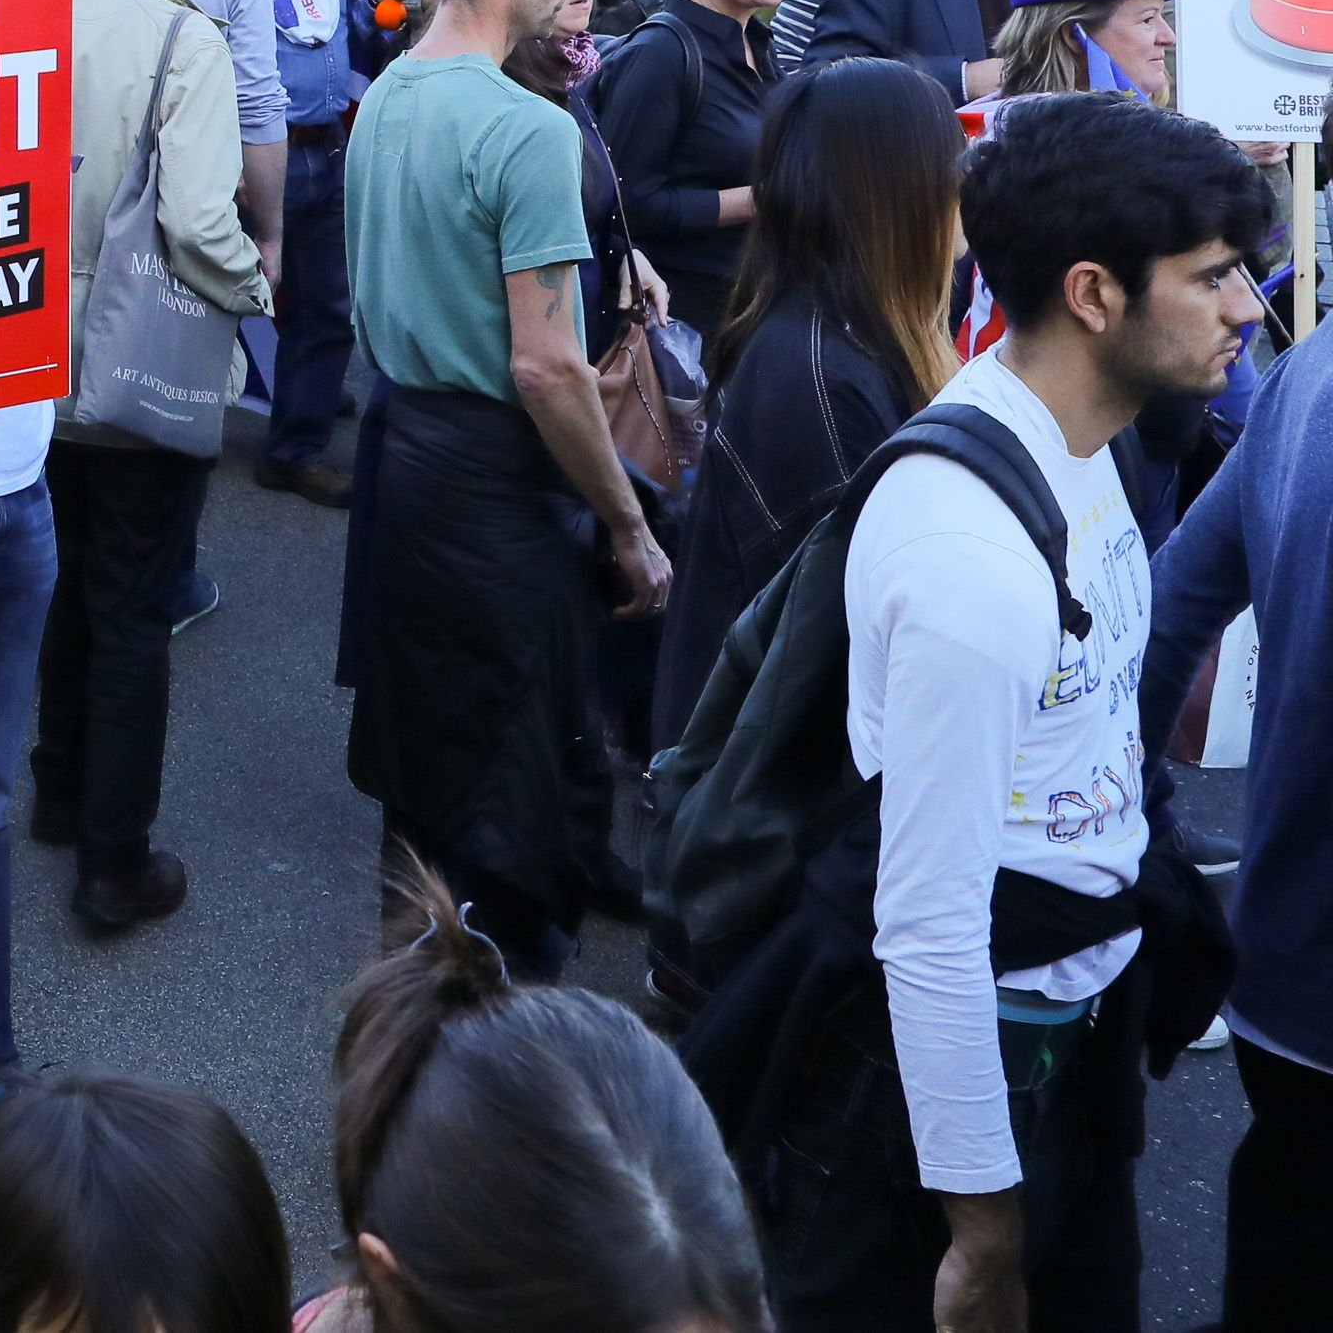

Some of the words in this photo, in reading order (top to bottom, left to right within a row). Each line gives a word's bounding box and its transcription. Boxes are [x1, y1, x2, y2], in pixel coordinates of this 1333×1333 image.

[1299, 106, 1324, 116] BRIT
[161, 287, 206, 318] LONDON
[112, 366, 139, 382] ART
[140, 373, 188, 401] ANTIQUES
[189, 389, 219, 404] DESIGN
